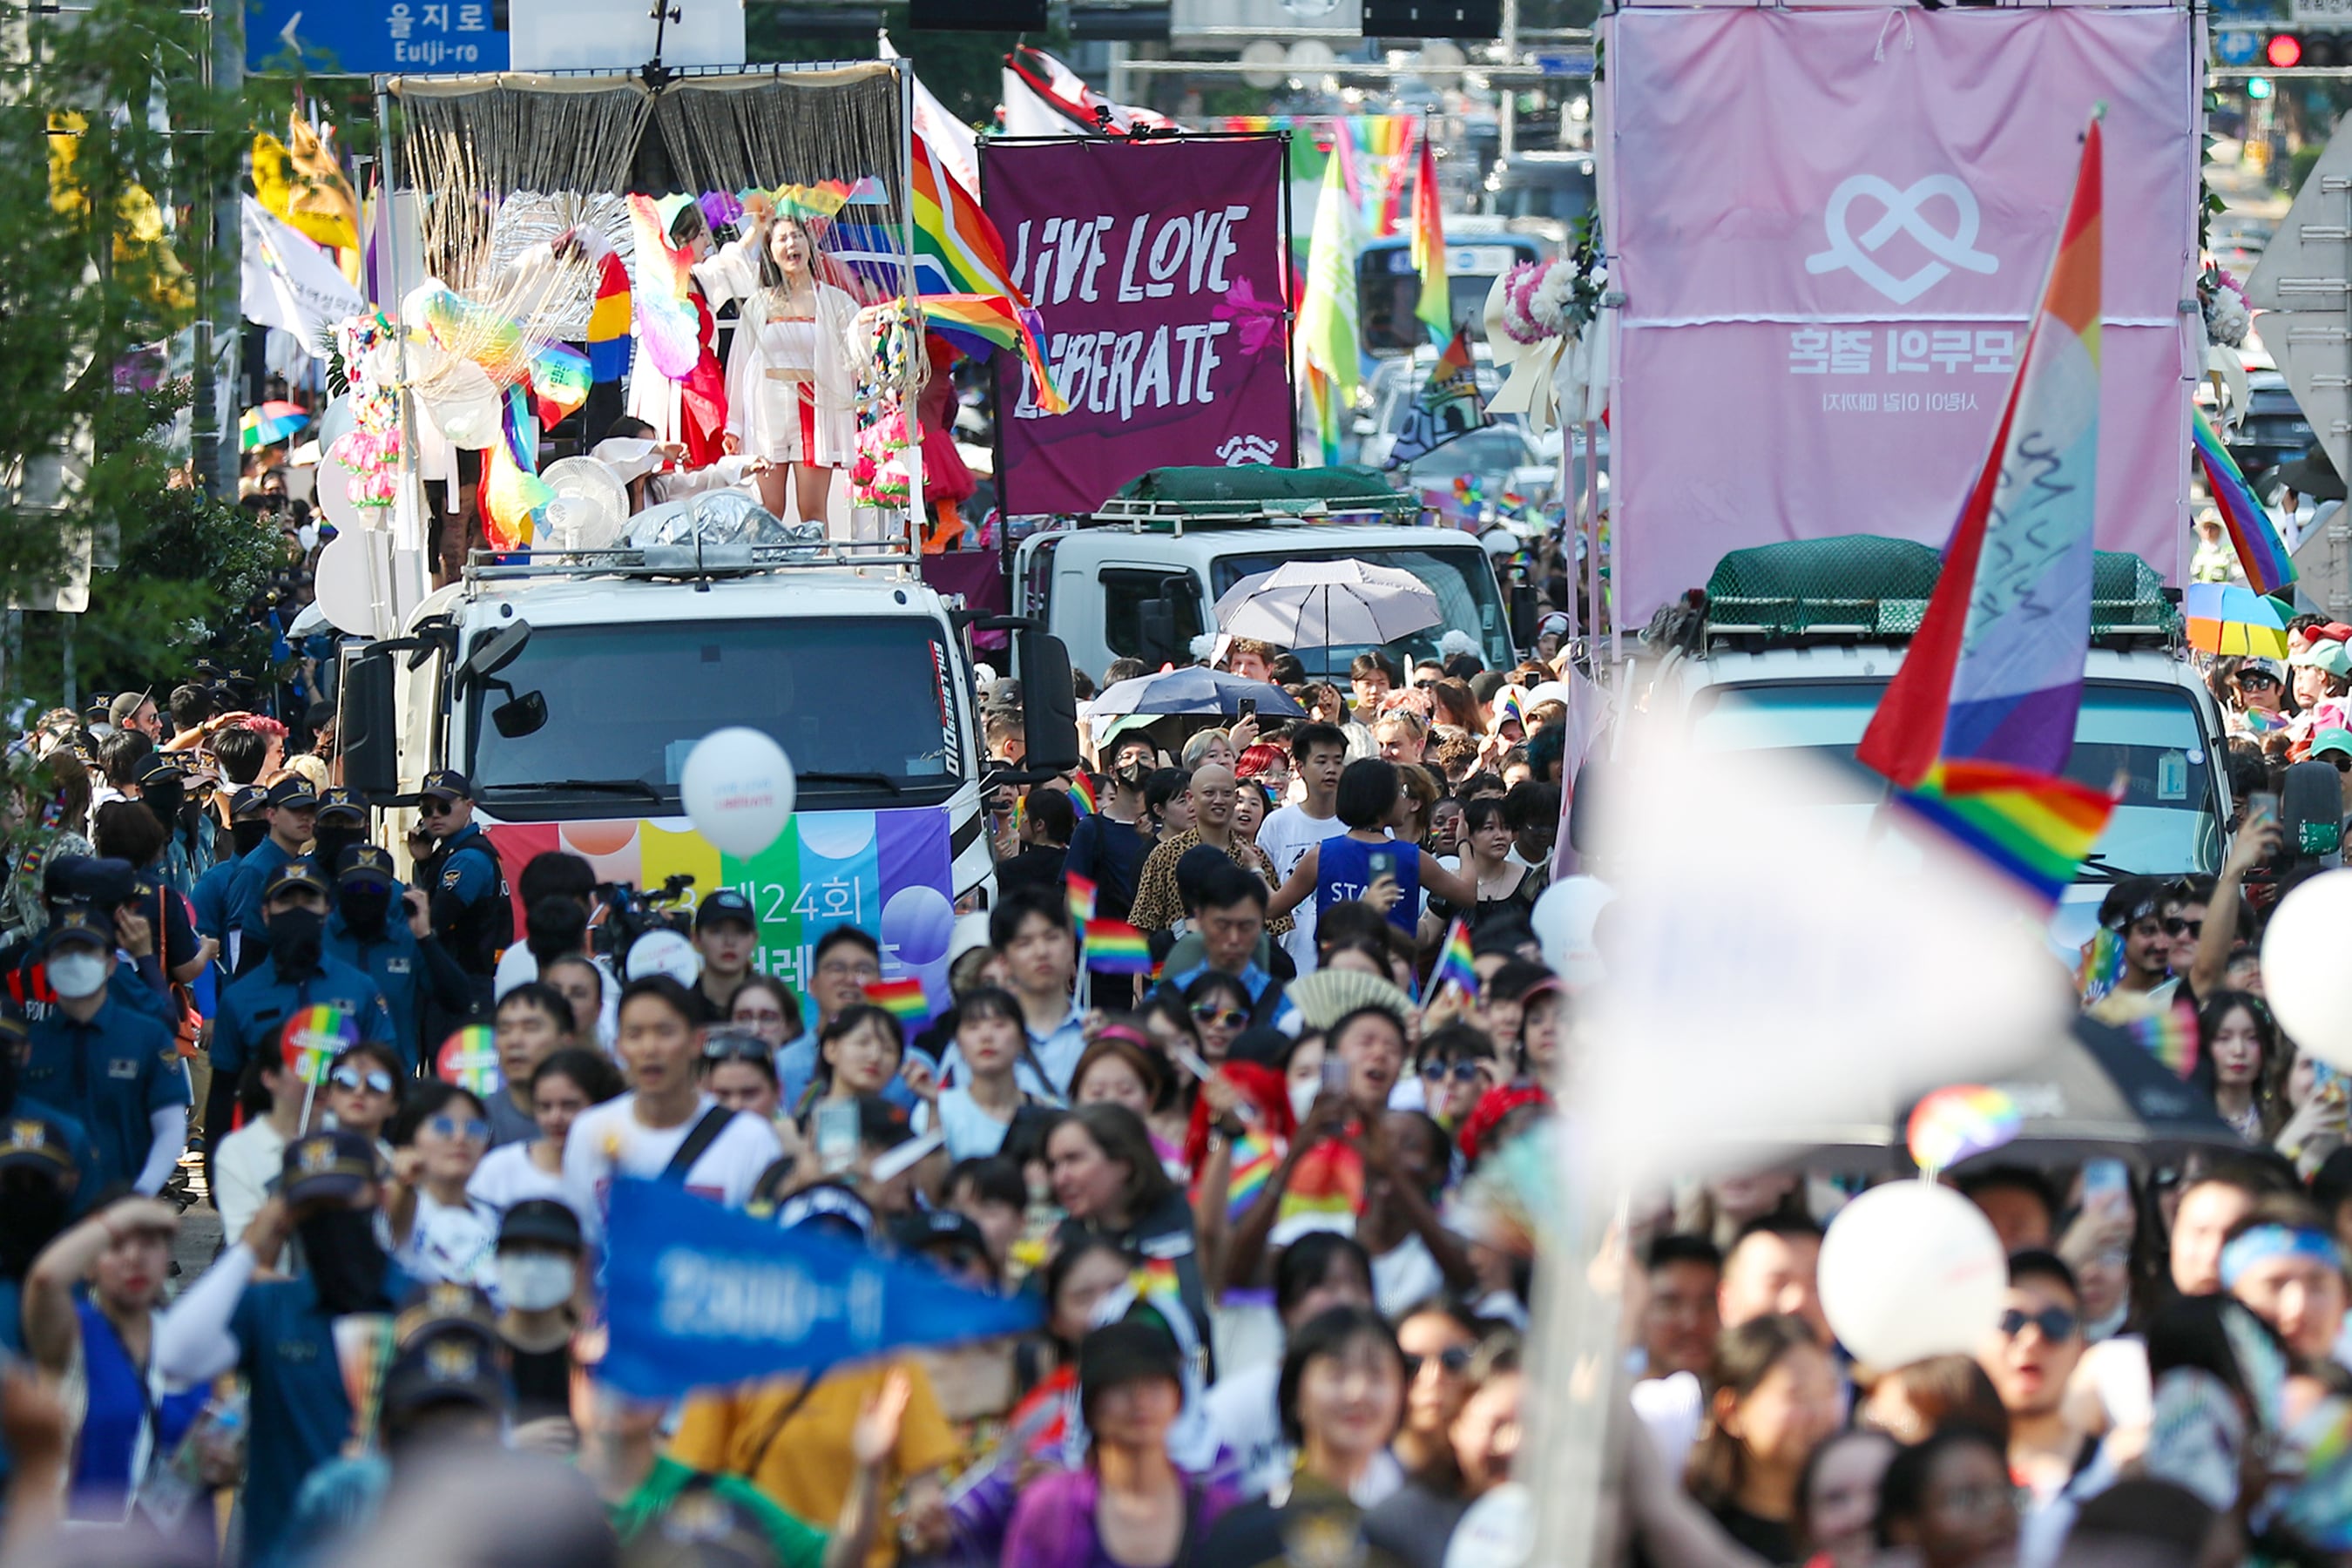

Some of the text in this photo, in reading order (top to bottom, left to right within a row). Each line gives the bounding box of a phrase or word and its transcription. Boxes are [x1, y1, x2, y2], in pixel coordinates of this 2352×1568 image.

[386, 3, 486, 38] 을지로
[395, 40, 479, 66] Eulji-ro
[1118, 206, 1249, 302] LOVE
